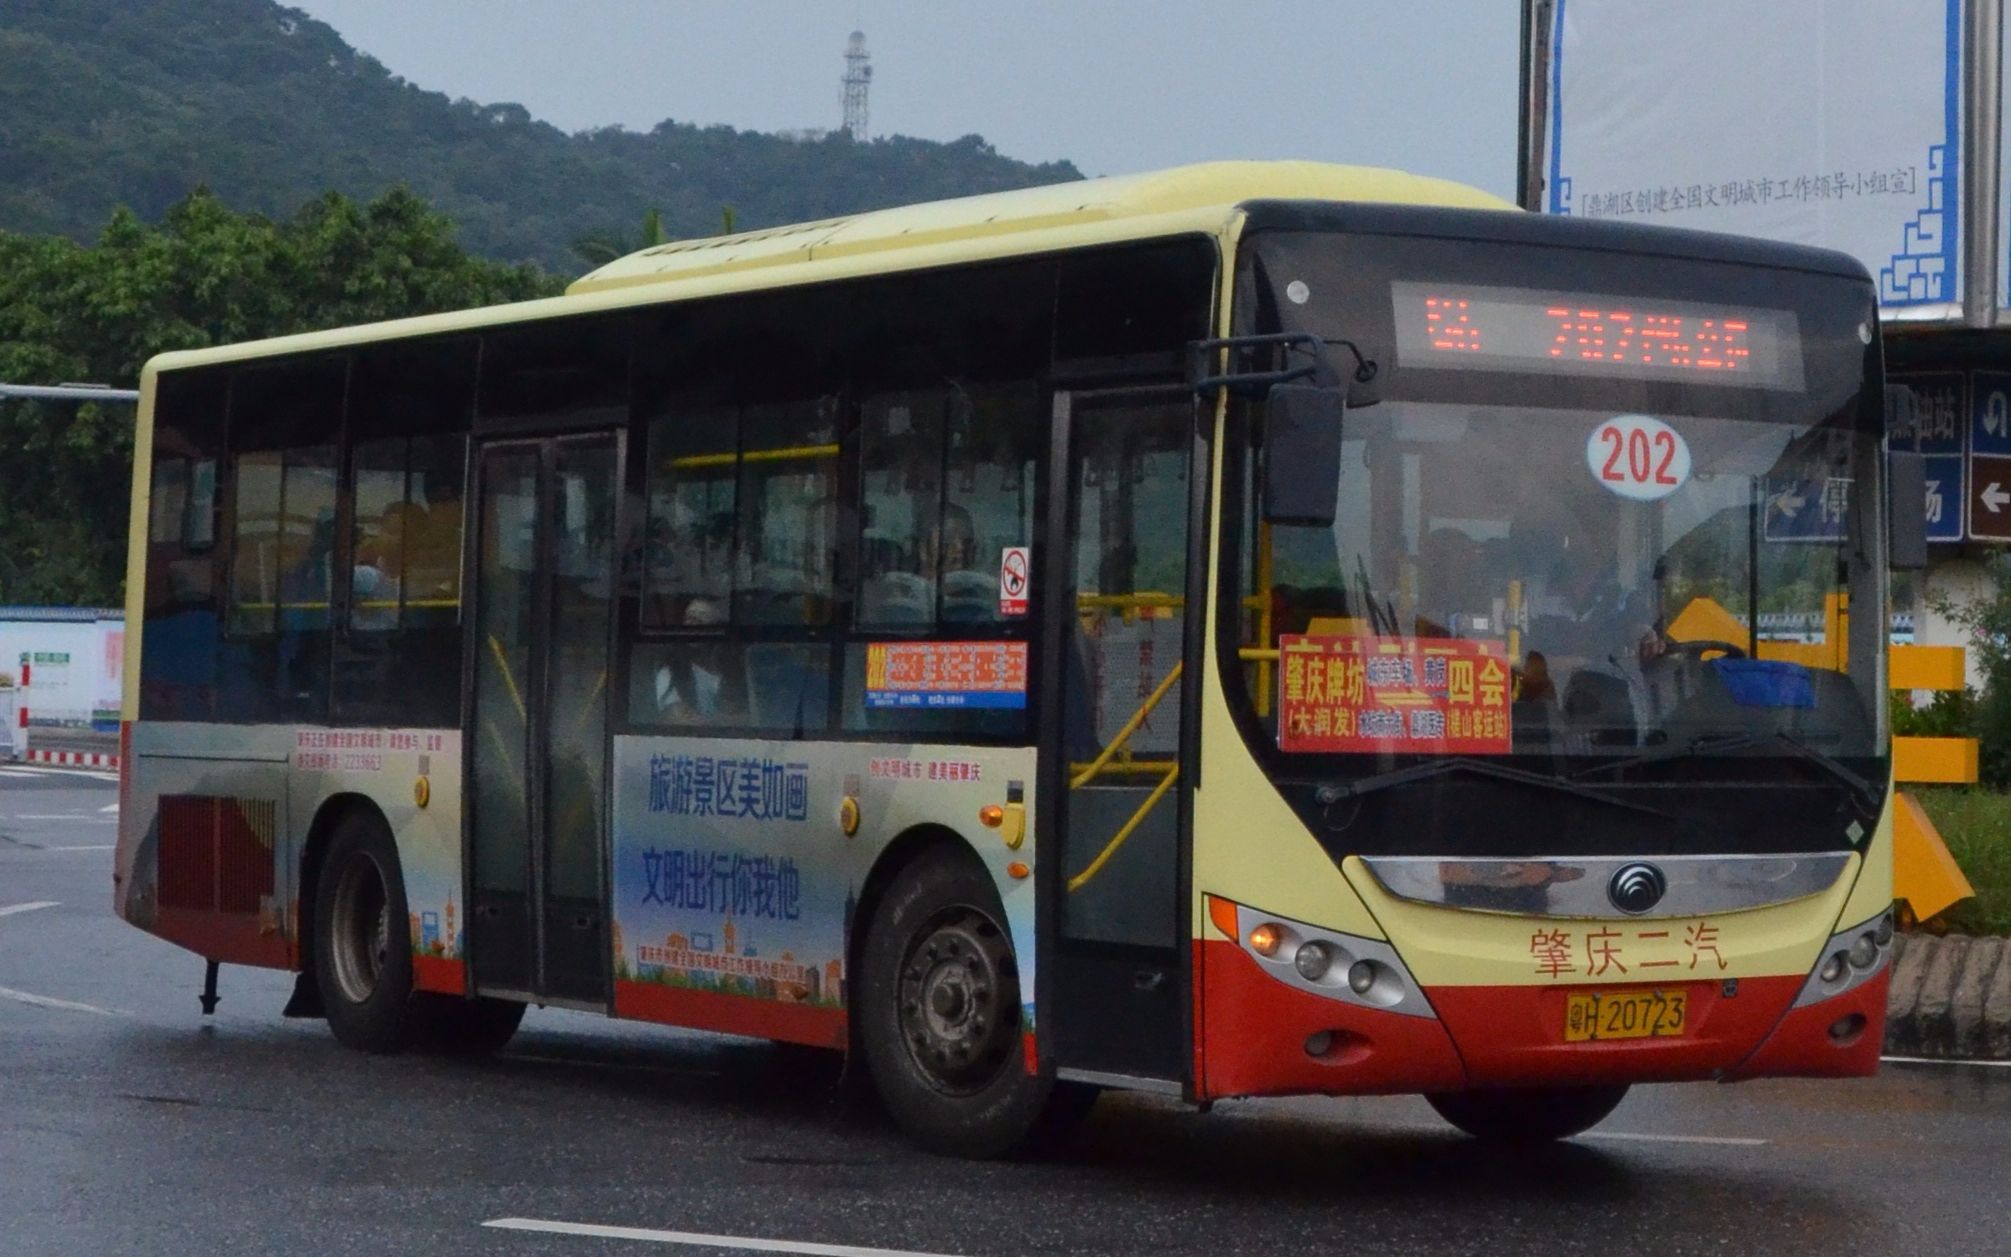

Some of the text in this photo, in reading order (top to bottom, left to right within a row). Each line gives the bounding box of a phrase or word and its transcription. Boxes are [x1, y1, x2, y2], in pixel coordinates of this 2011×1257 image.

[1601, 427, 1678, 484] 202
[1286, 654, 1364, 705] 肇庆牌坊
[1451, 659, 1504, 706] 四会
[649, 753, 809, 822] 旅游景区美如画
[641, 846, 800, 920] 文明出行你我他
[1530, 922, 1728, 979] 肇庆二汽
